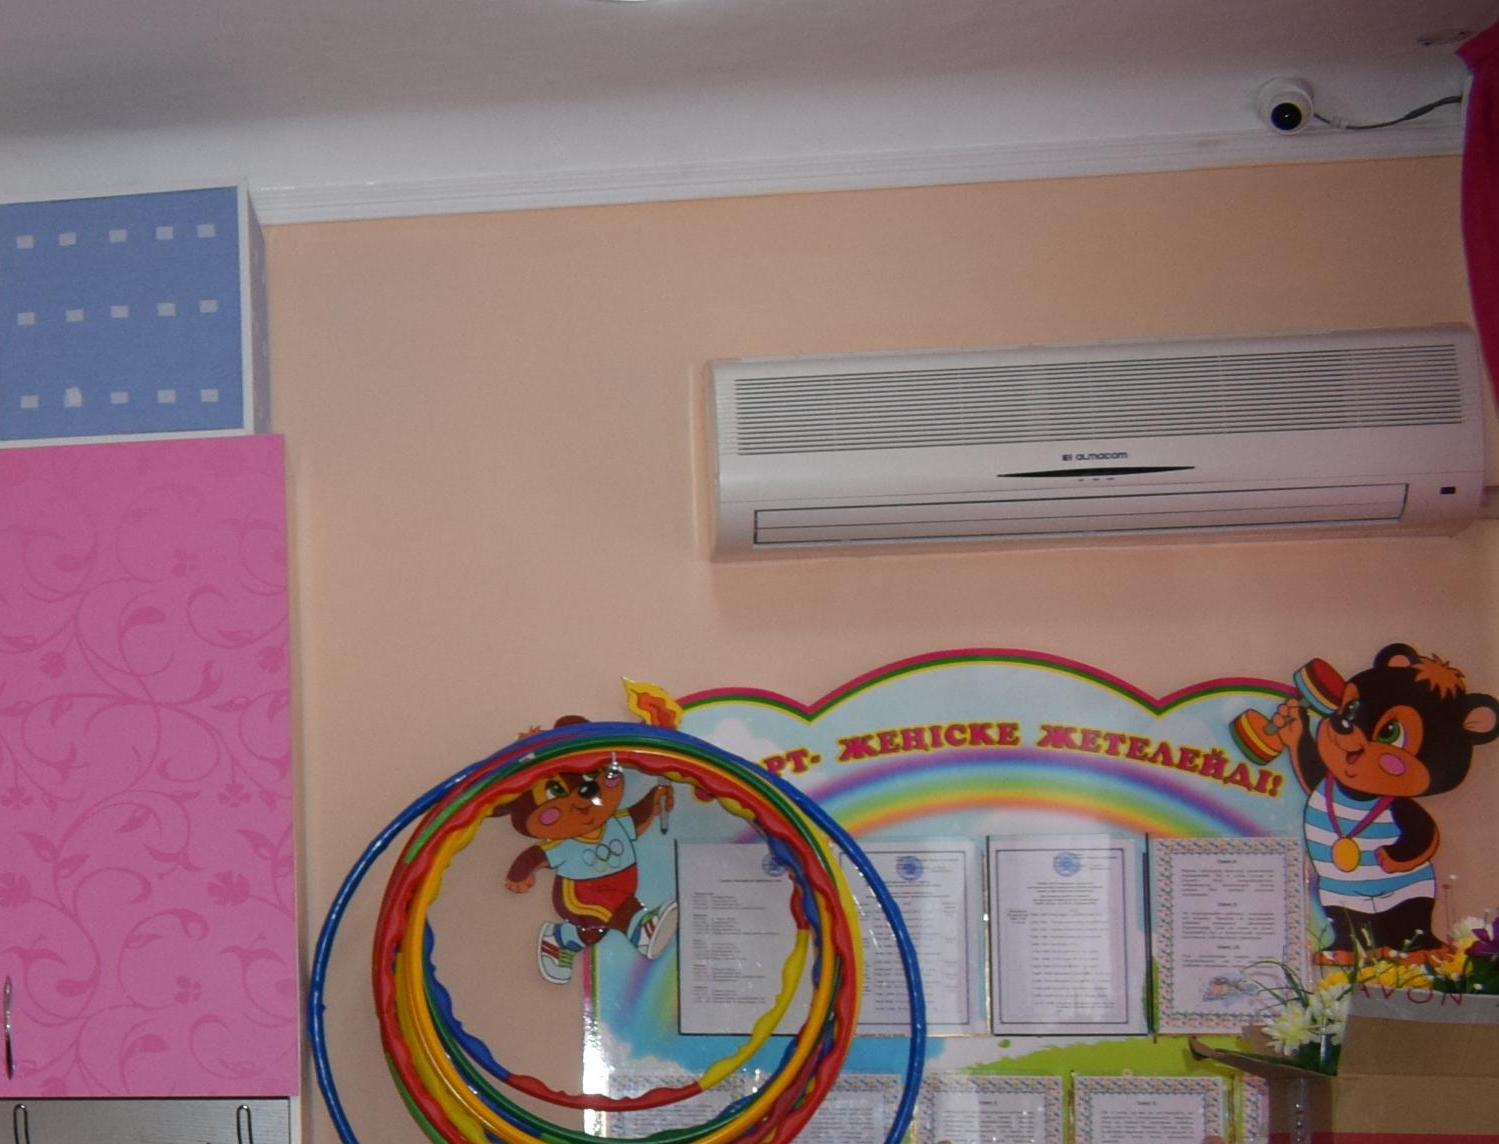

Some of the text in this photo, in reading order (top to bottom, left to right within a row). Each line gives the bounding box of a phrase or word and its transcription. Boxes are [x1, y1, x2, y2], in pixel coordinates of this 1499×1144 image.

[761, 722, 1284, 796] РТ- ЖЕҢІСКЕ ЖЕТЕЛЕЙДІ!
